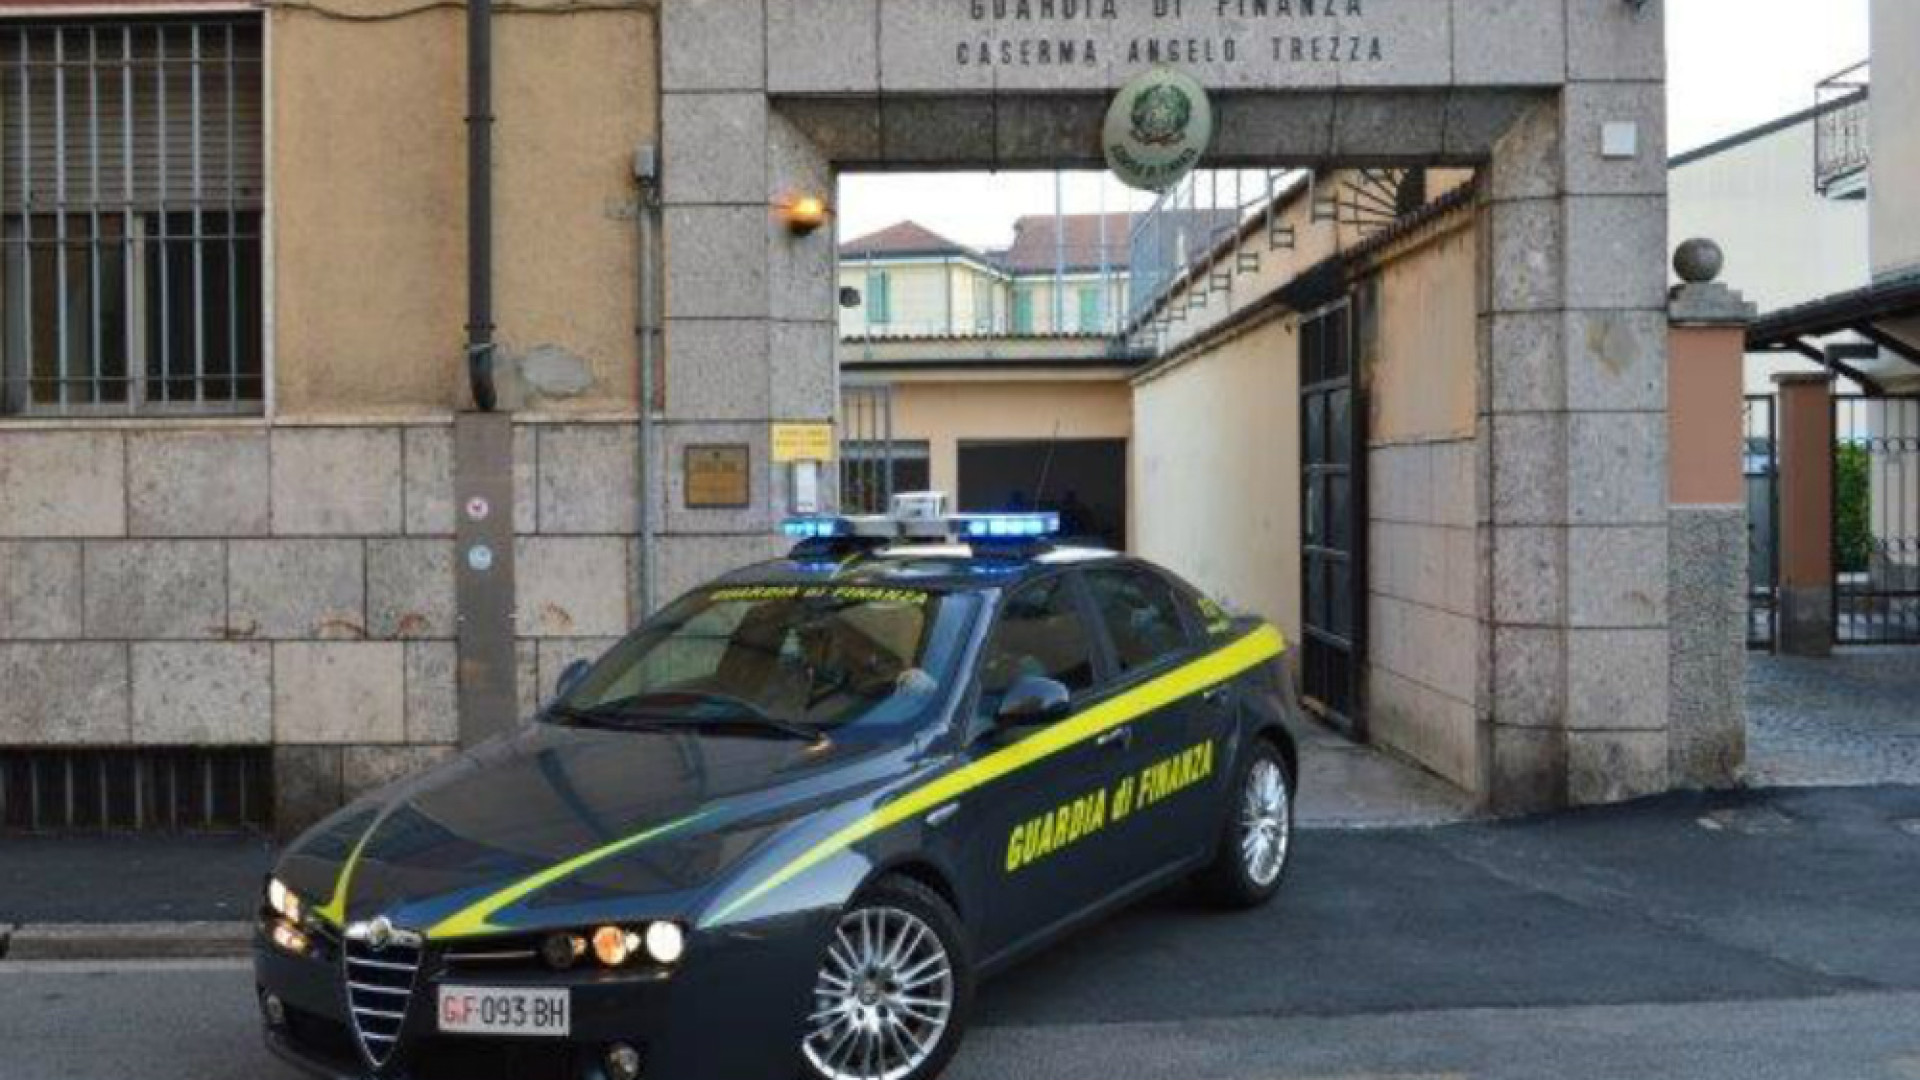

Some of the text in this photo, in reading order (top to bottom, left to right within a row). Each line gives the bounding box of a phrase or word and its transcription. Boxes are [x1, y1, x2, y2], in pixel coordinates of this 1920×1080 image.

[971, 0, 1363, 20] GUARDIA DI FINANZA
[956, 35, 1383, 66] CASERMA ANGELO TREZZA
[1006, 786, 1107, 873] GUARDIA
[1136, 738, 1213, 810] FINANZA
